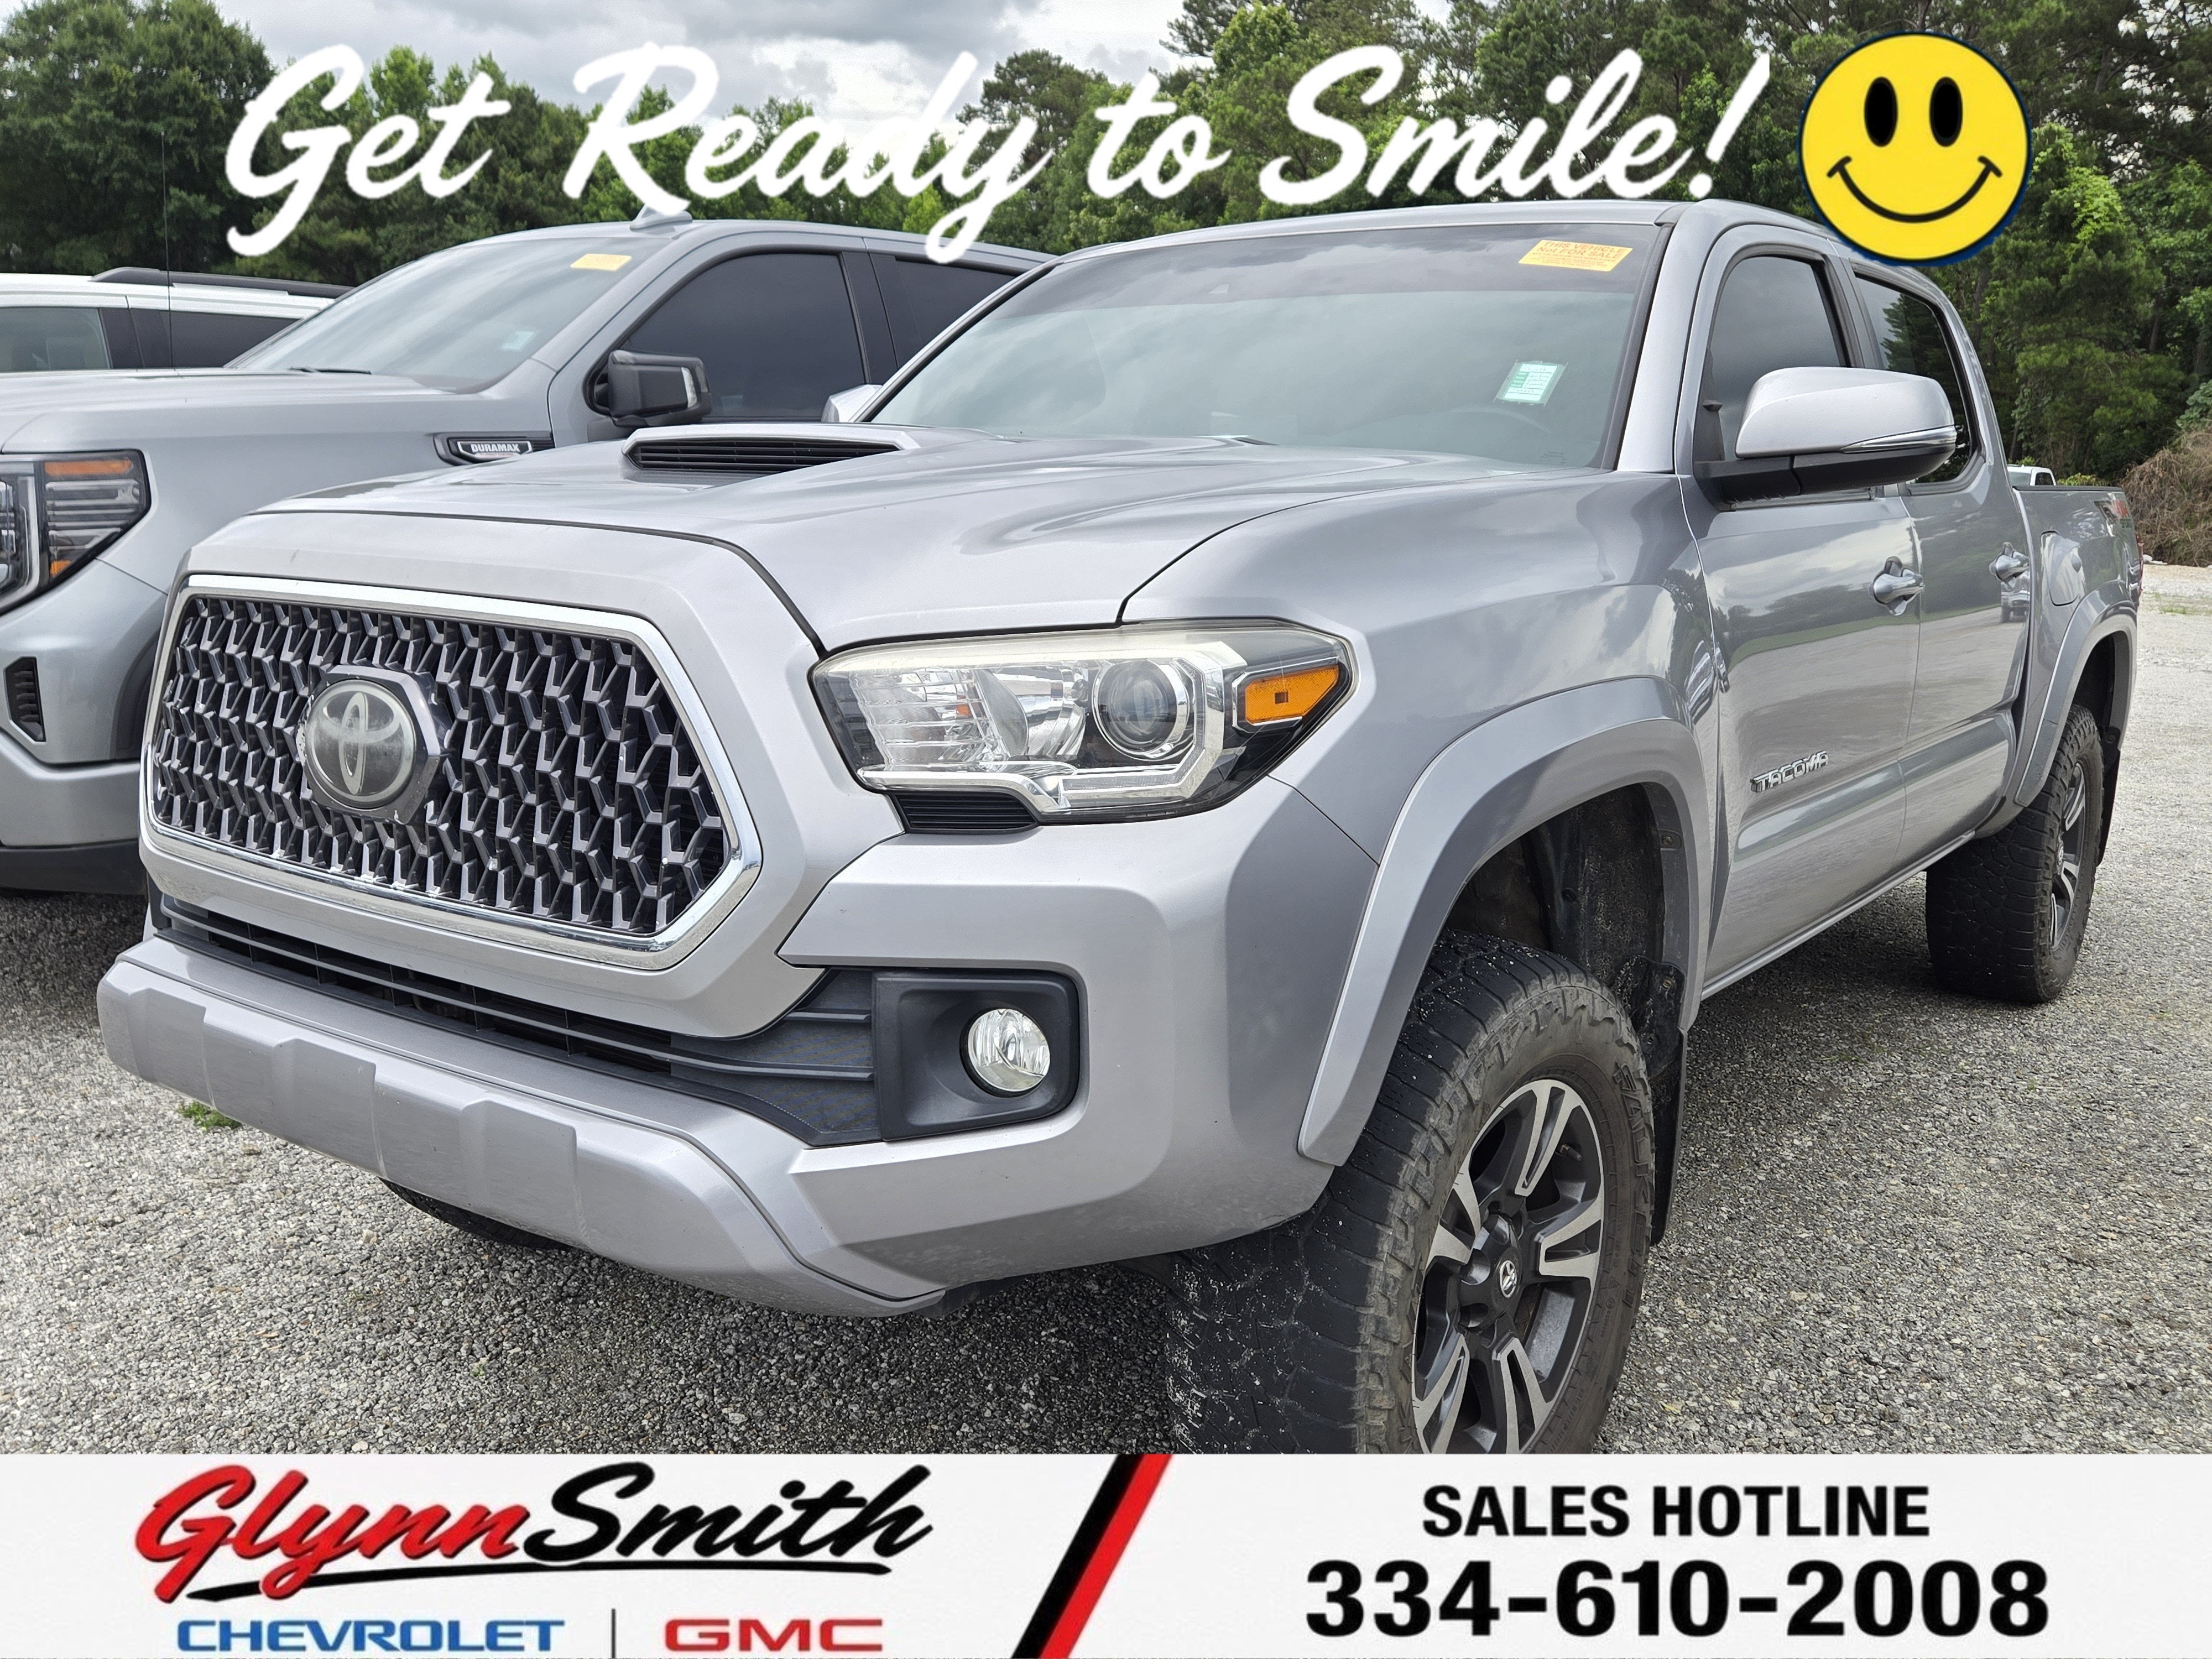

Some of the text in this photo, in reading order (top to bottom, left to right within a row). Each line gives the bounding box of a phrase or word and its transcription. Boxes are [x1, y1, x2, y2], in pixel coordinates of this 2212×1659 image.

[1574, 244, 1625, 253] VEHICLE
[1589, 251, 1623, 259] SALE
[471, 444, 520, 452] DURAMAX
[1750, 750, 1829, 792] TACOMA
